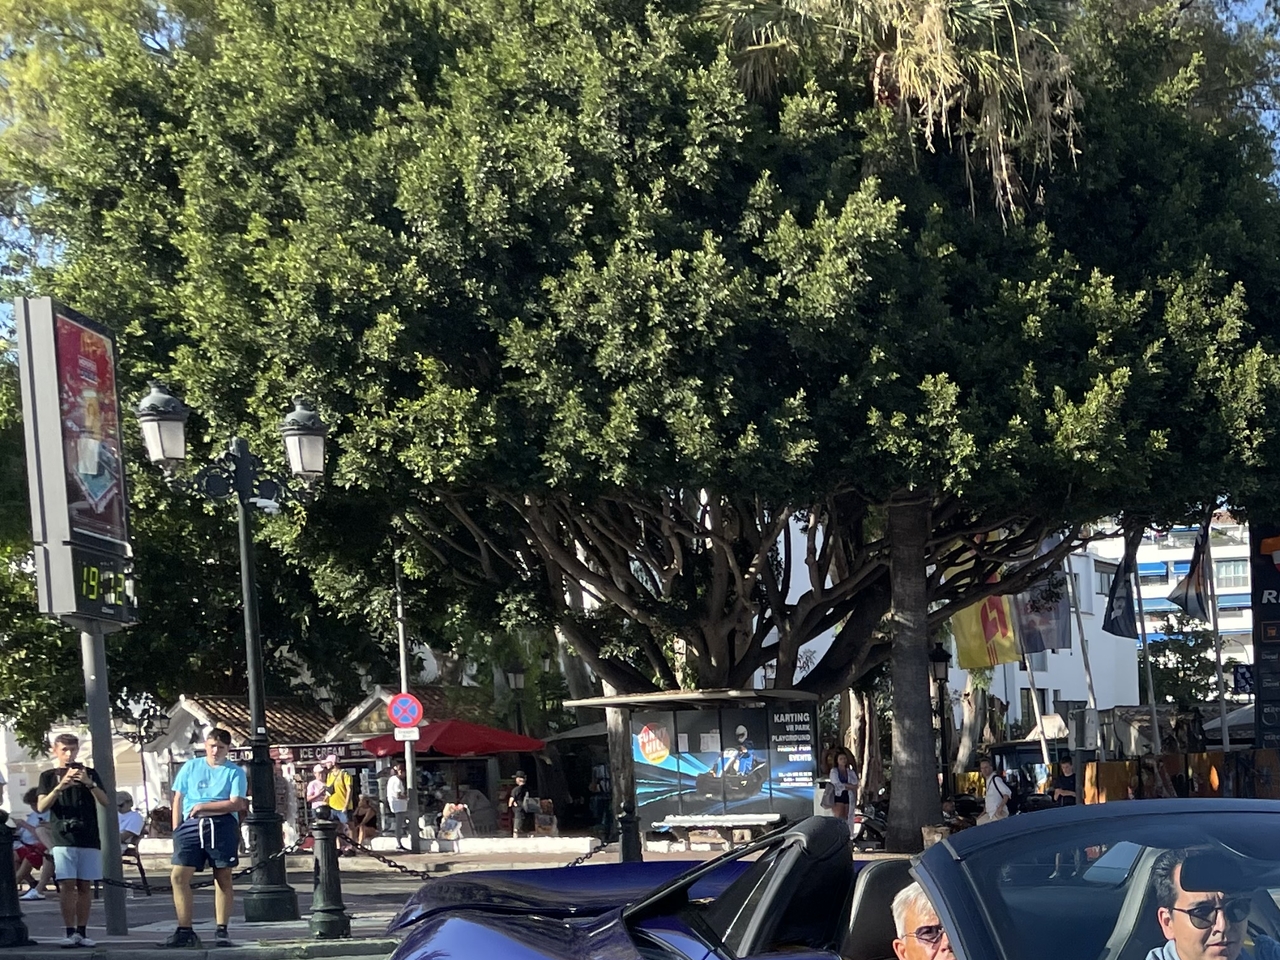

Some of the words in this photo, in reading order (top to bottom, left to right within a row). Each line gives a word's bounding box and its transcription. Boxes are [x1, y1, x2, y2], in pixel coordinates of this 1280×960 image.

[1261, 652, 1279, 660] Diesel
[773, 713, 810, 723] KARTING
[785, 724, 795, 732] VR
[771, 734, 811, 742] PLAYGROUND
[799, 744, 812, 752] FUN
[300, 748, 314, 758] ICE
